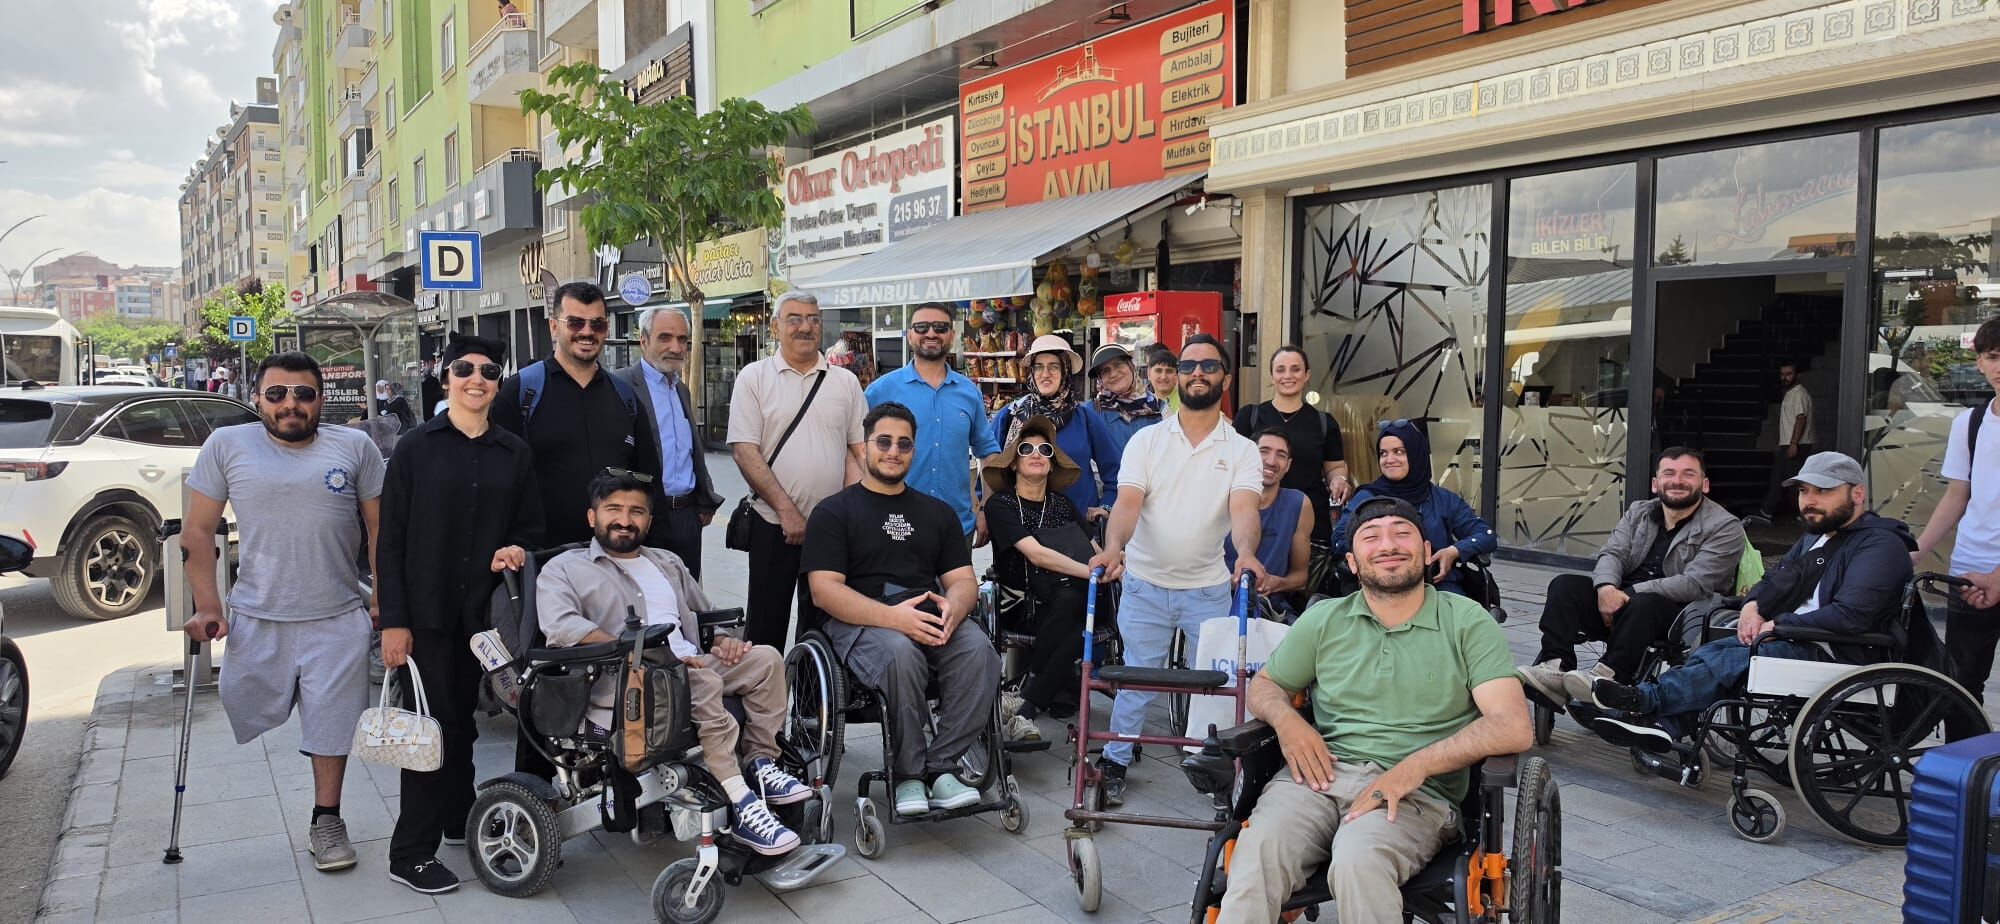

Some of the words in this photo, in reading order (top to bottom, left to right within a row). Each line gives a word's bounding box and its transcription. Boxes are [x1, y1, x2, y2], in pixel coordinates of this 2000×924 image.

[1172, 24, 1209, 44] Bujiteri
[1170, 50, 1212, 73] Ambalaj
[967, 90, 999, 107] Kırtasiye
[1171, 82, 1210, 104] Elektrik
[967, 114, 1001, 131] Züccaciye
[1010, 82, 1155, 167] İSTANBUL
[970, 138, 1000, 156] Oyuncak
[1166, 144, 1197, 161] Mutfak
[787, 166, 837, 206] Okur
[841, 125, 945, 193] Ortopedi
[976, 162, 996, 176] Çeyiz
[1043, 160, 1110, 200] AVM
[970, 184, 1000, 200] Hediyelik
[893, 203, 912, 223] 215
[913, 199, 926, 219] 96
[928, 195, 941, 215] 37
[1531, 238, 1570, 256] BİLEN
[1574, 233, 1609, 252] BİLİR
[438, 246, 464, 276] D
[724, 257, 754, 282] Usta
[925, 278, 971, 298] AVM
[236, 322, 248, 335] D
[477, 641, 492, 658] ALL
